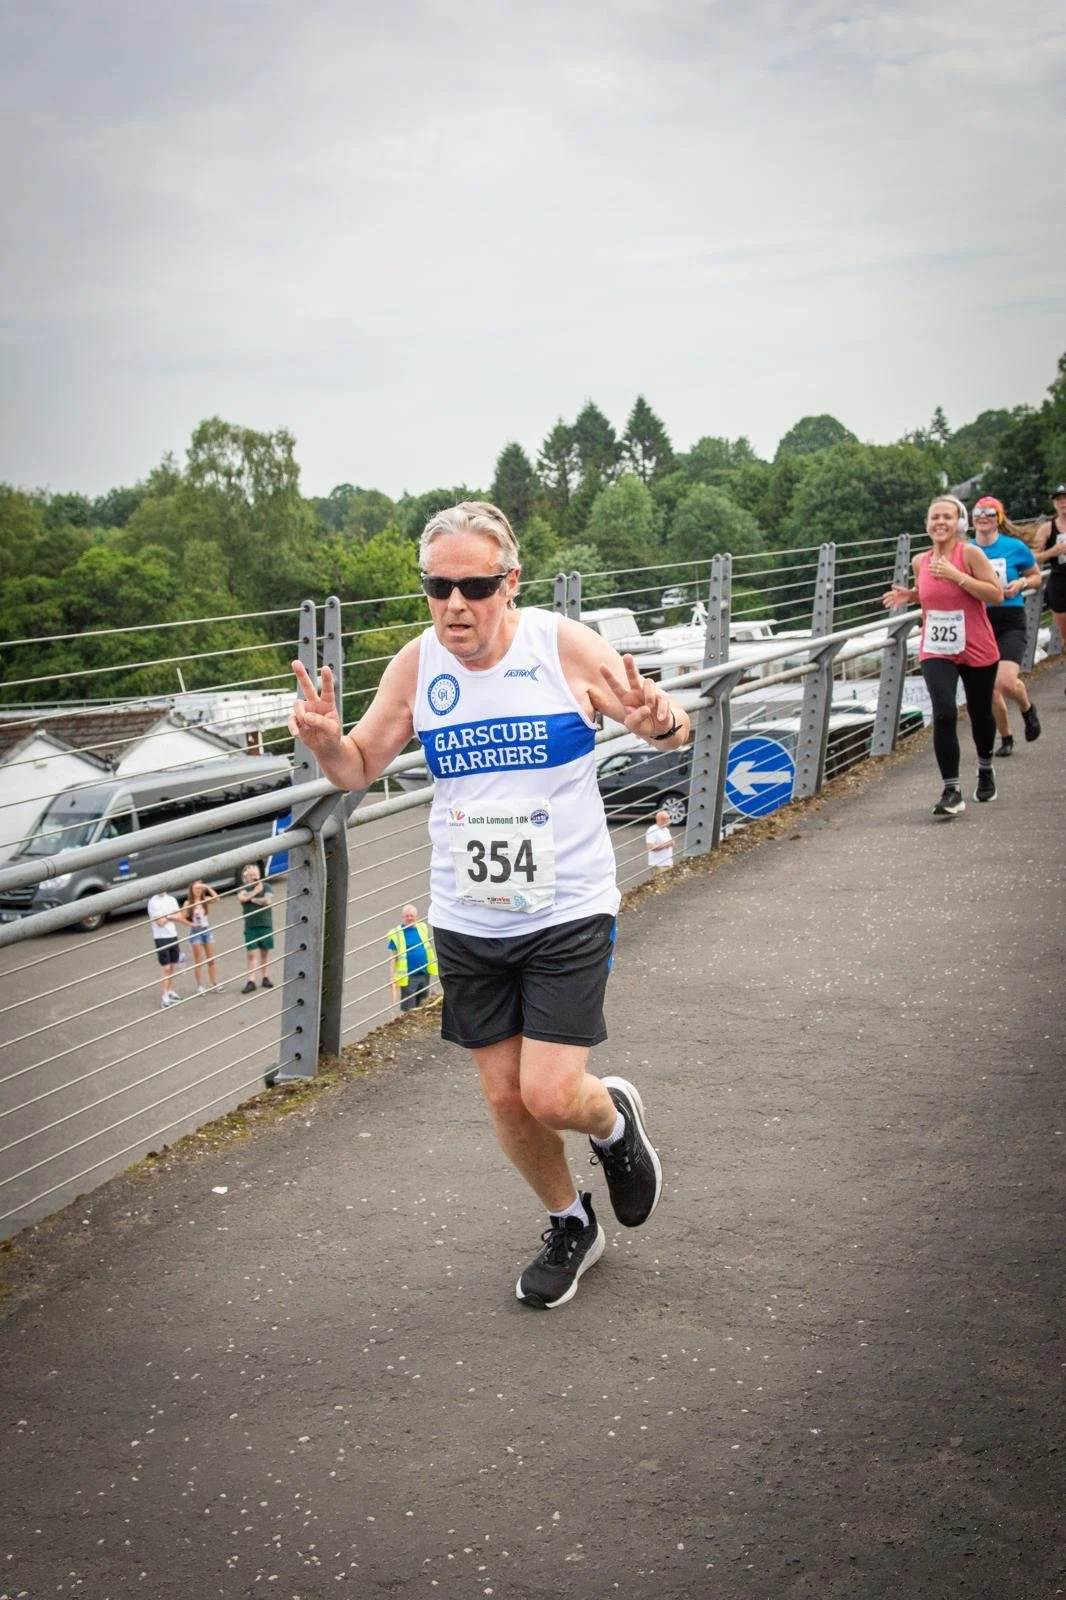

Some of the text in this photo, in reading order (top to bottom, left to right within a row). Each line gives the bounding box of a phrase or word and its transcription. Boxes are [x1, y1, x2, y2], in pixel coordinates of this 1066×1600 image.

[931, 625, 957, 642] 325
[435, 721, 549, 753] GARSCUBE
[438, 744, 548, 774] HARRIERS
[468, 816, 484, 824] Loch
[486, 816, 513, 824] Lomond
[516, 816, 529, 824] 10k
[467, 839, 538, 884] 354
